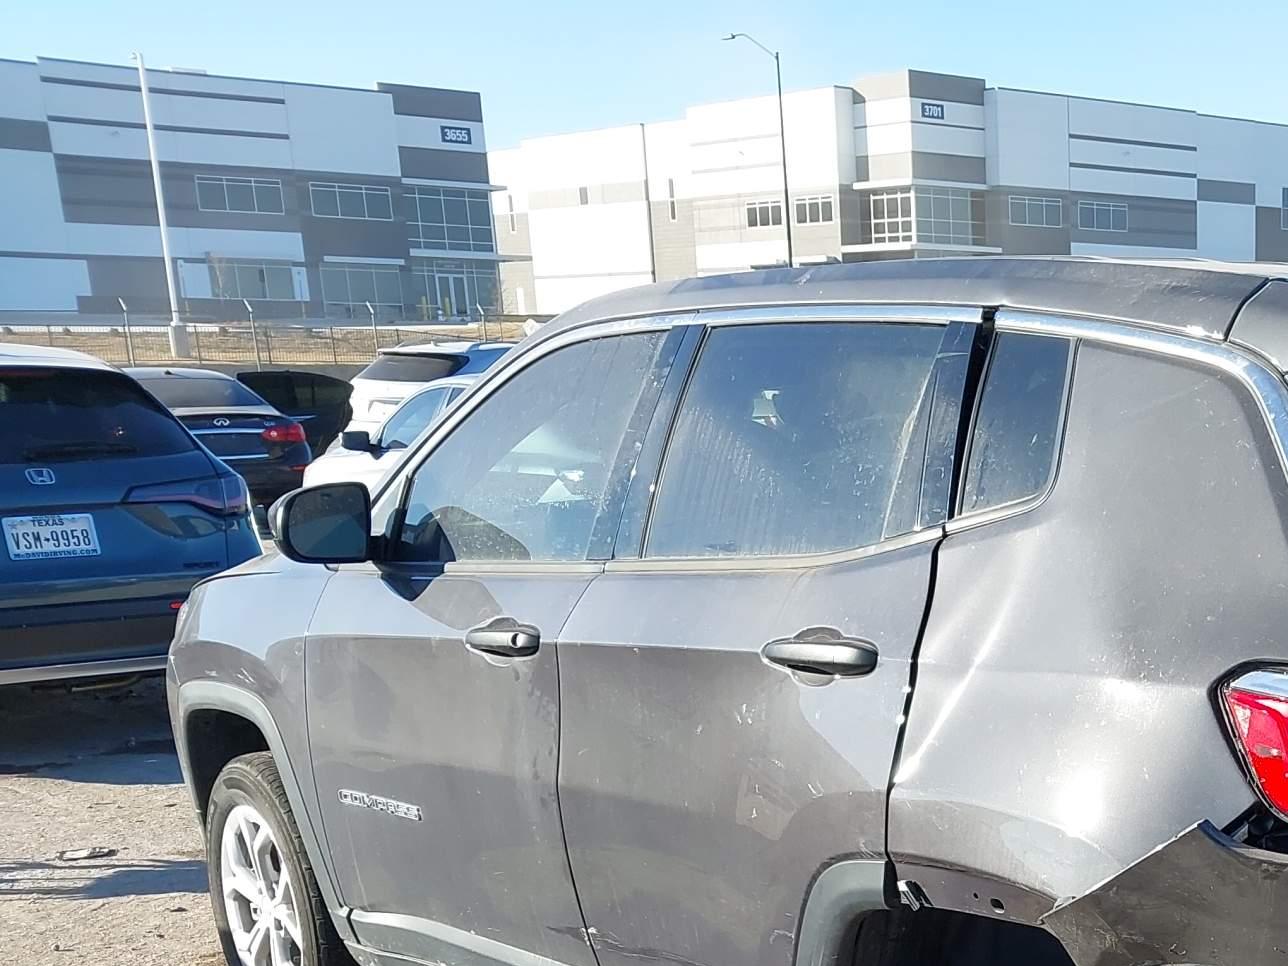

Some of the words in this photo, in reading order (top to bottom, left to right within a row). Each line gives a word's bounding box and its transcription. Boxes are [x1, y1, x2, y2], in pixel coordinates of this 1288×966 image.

[924, 105, 942, 117] 3701
[444, 128, 468, 141] 3655
[31, 518, 65, 527] TEXAS
[338, 789, 422, 821] COMPASS
